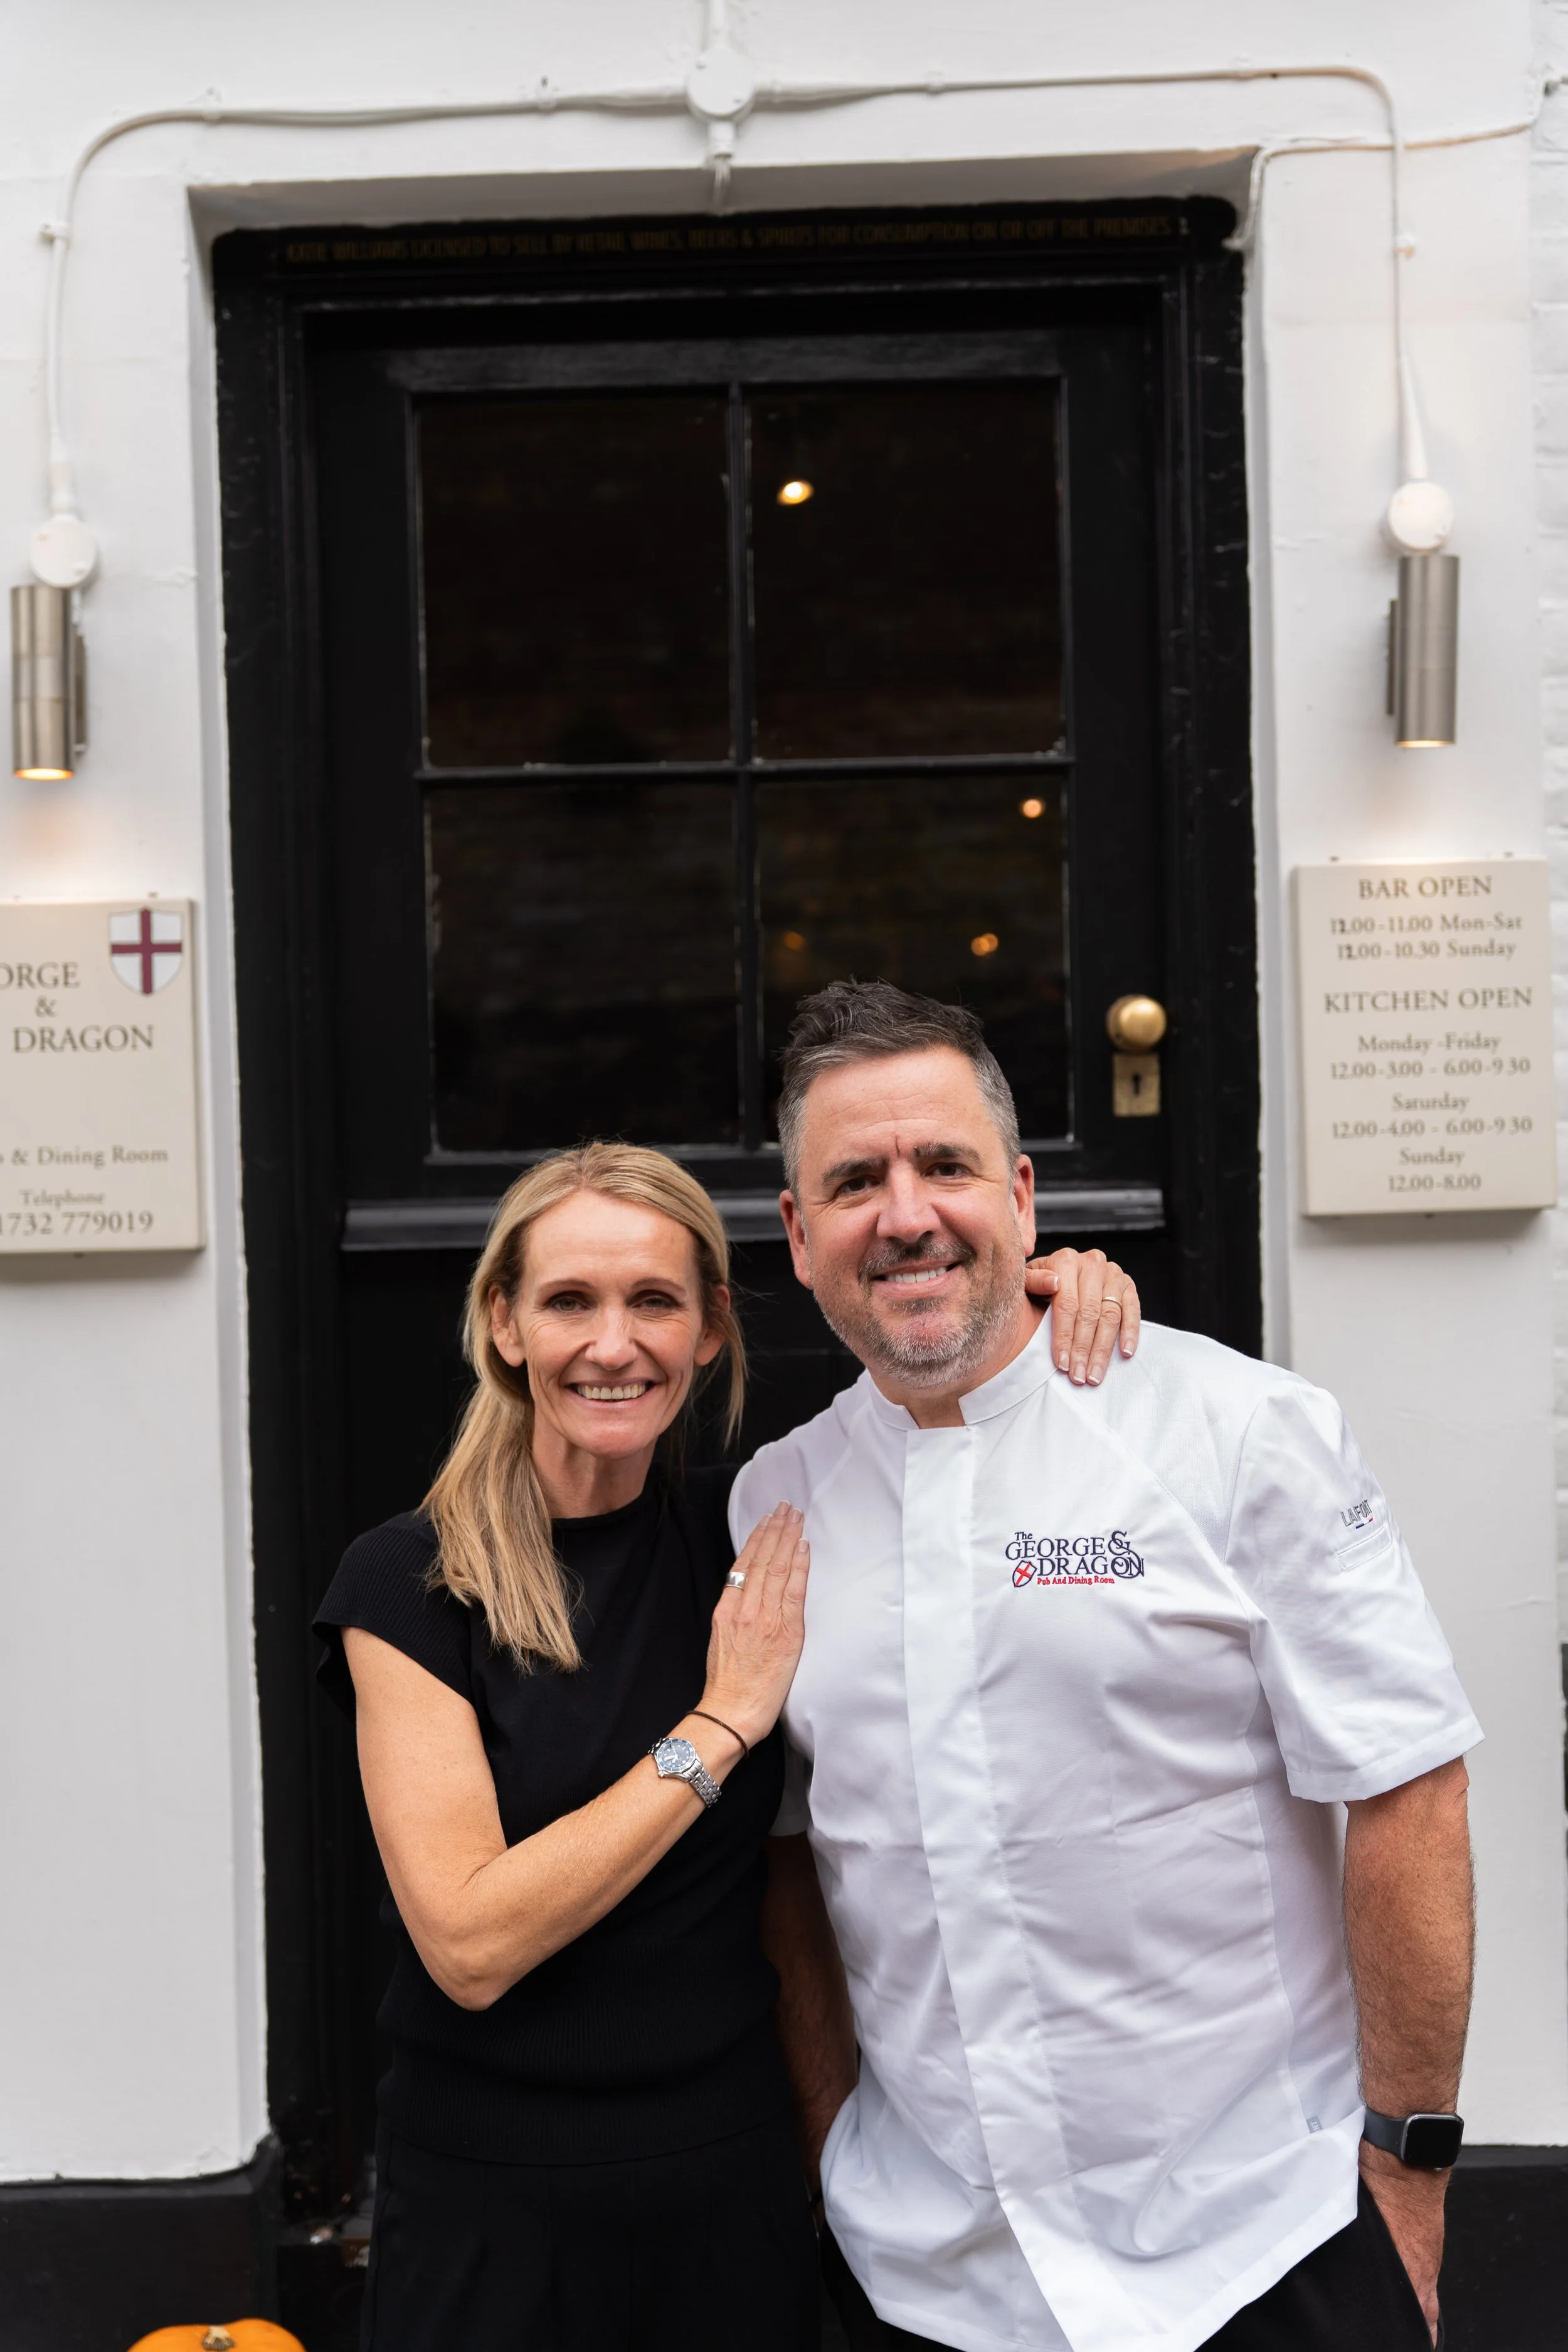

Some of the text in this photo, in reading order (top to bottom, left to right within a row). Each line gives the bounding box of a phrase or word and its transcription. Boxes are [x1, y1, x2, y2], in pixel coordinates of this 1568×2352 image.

[1359, 875, 1493, 900] BAR OPEN
[1446, 938, 1517, 961] Sunday
[34, 995, 57, 1017] &
[1324, 987, 1532, 1013] KITCHEN OPEN
[13, 1025, 154, 1053] DRAGON
[1358, 1032, 1433, 1056] Monday
[1392, 1091, 1470, 1113] Saturday
[11, 1147, 29, 1166] &
[38, 1145, 106, 1170] Dining
[112, 1144, 168, 1164] Room
[1399, 1146, 1466, 1168] Sunday
[19, 1188, 105, 1210] Telephone
[61, 1210, 154, 1236] 779019
[1015, 1532, 1033, 1540] The
[1005, 1537, 1106, 1560] GEORGE
[1037, 1556, 1145, 1579] DRAGON
[1037, 1576, 1115, 1586] Pub And Dining Room
